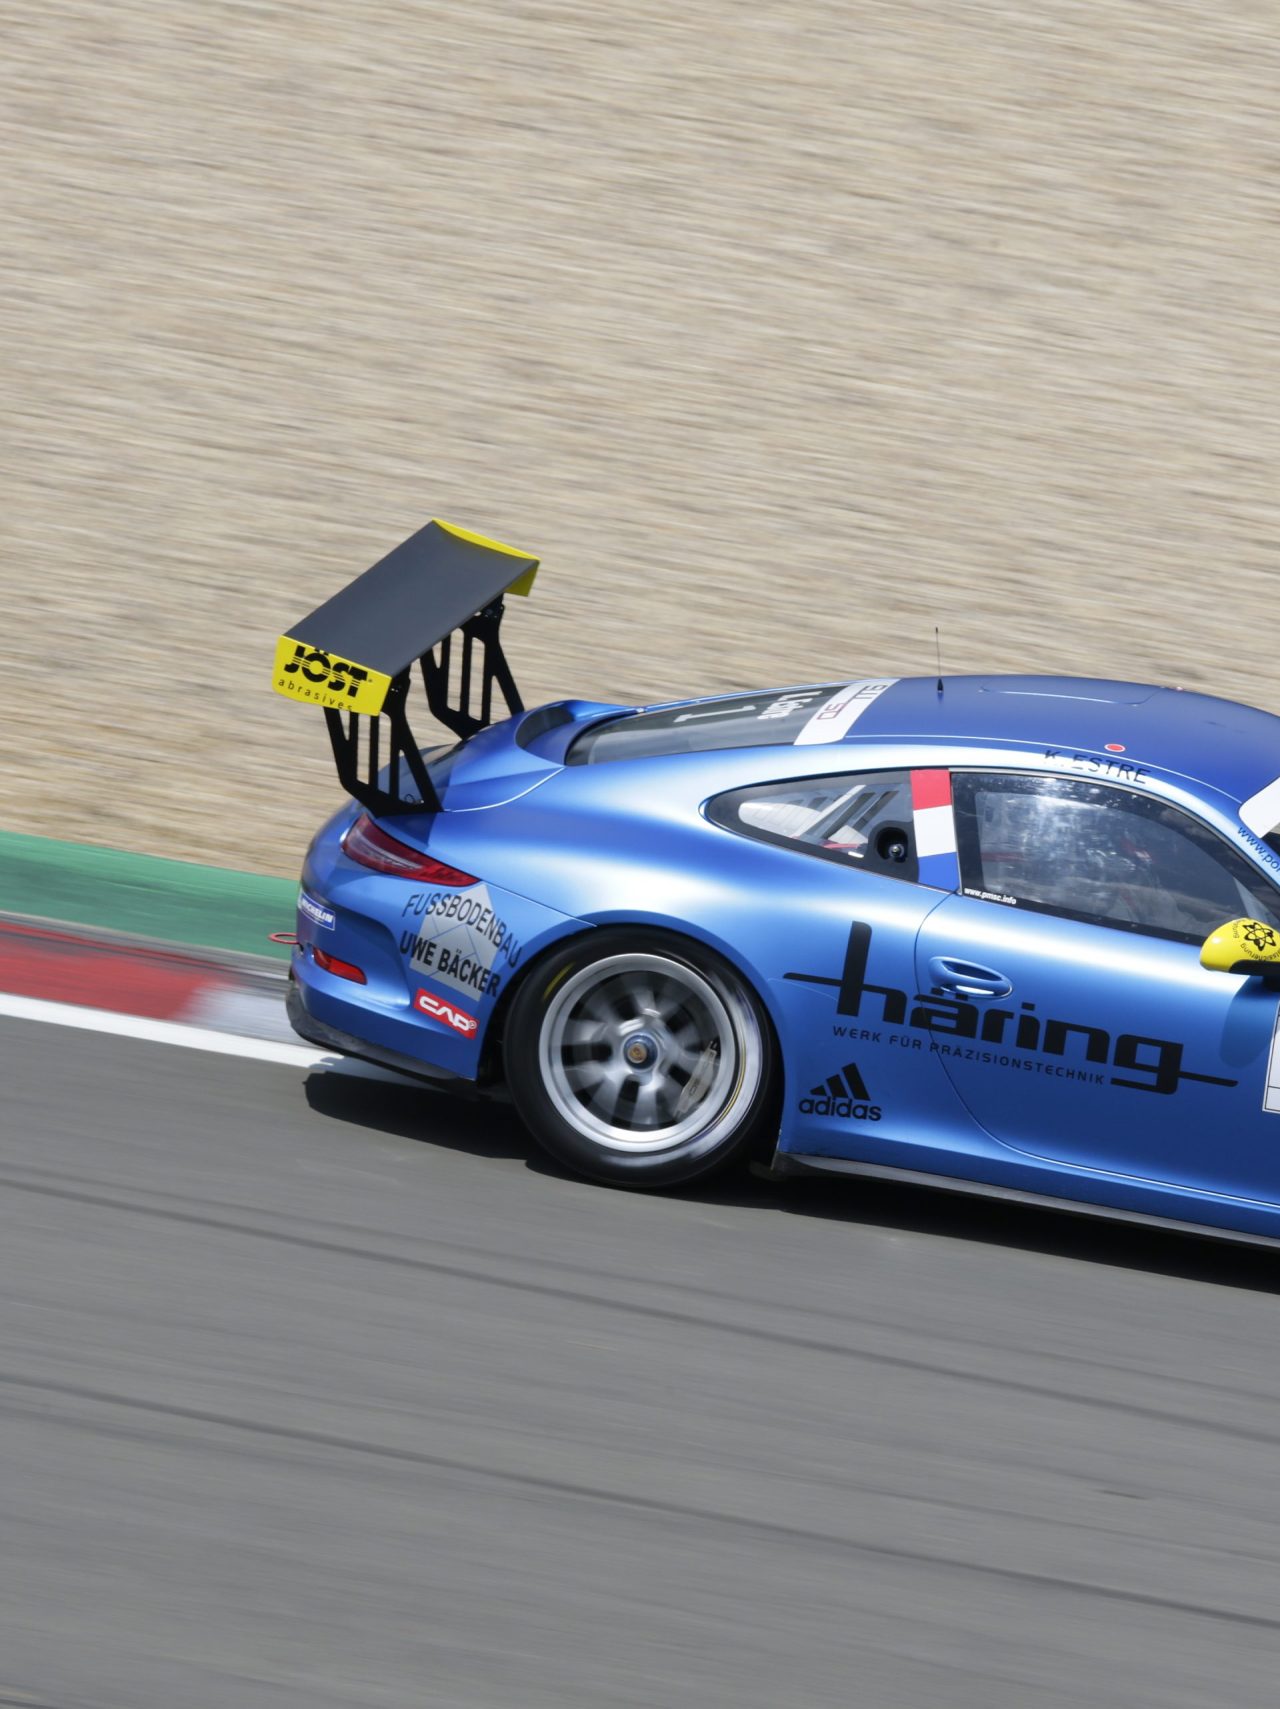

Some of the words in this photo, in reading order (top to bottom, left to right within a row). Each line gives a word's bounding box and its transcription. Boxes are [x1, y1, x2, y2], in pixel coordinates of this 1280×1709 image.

[673, 705, 756, 723] 1
[1072, 754, 1151, 784] ESTRE
[963, 887, 1017, 905] www.pmsc.info
[402, 893, 522, 969] FUSSBODENBAU
[401, 930, 434, 966] UWE
[439, 949, 501, 999] BÄCKER
[419, 995, 471, 1032] CAP
[782, 920, 1239, 1095] häring
[832, 1025, 882, 1045] WERK
[888, 1034, 923, 1052] FÜR
[928, 1041, 1105, 1086] PRÄZISIONSTECHNIK
[798, 1097, 882, 1122] adidas
